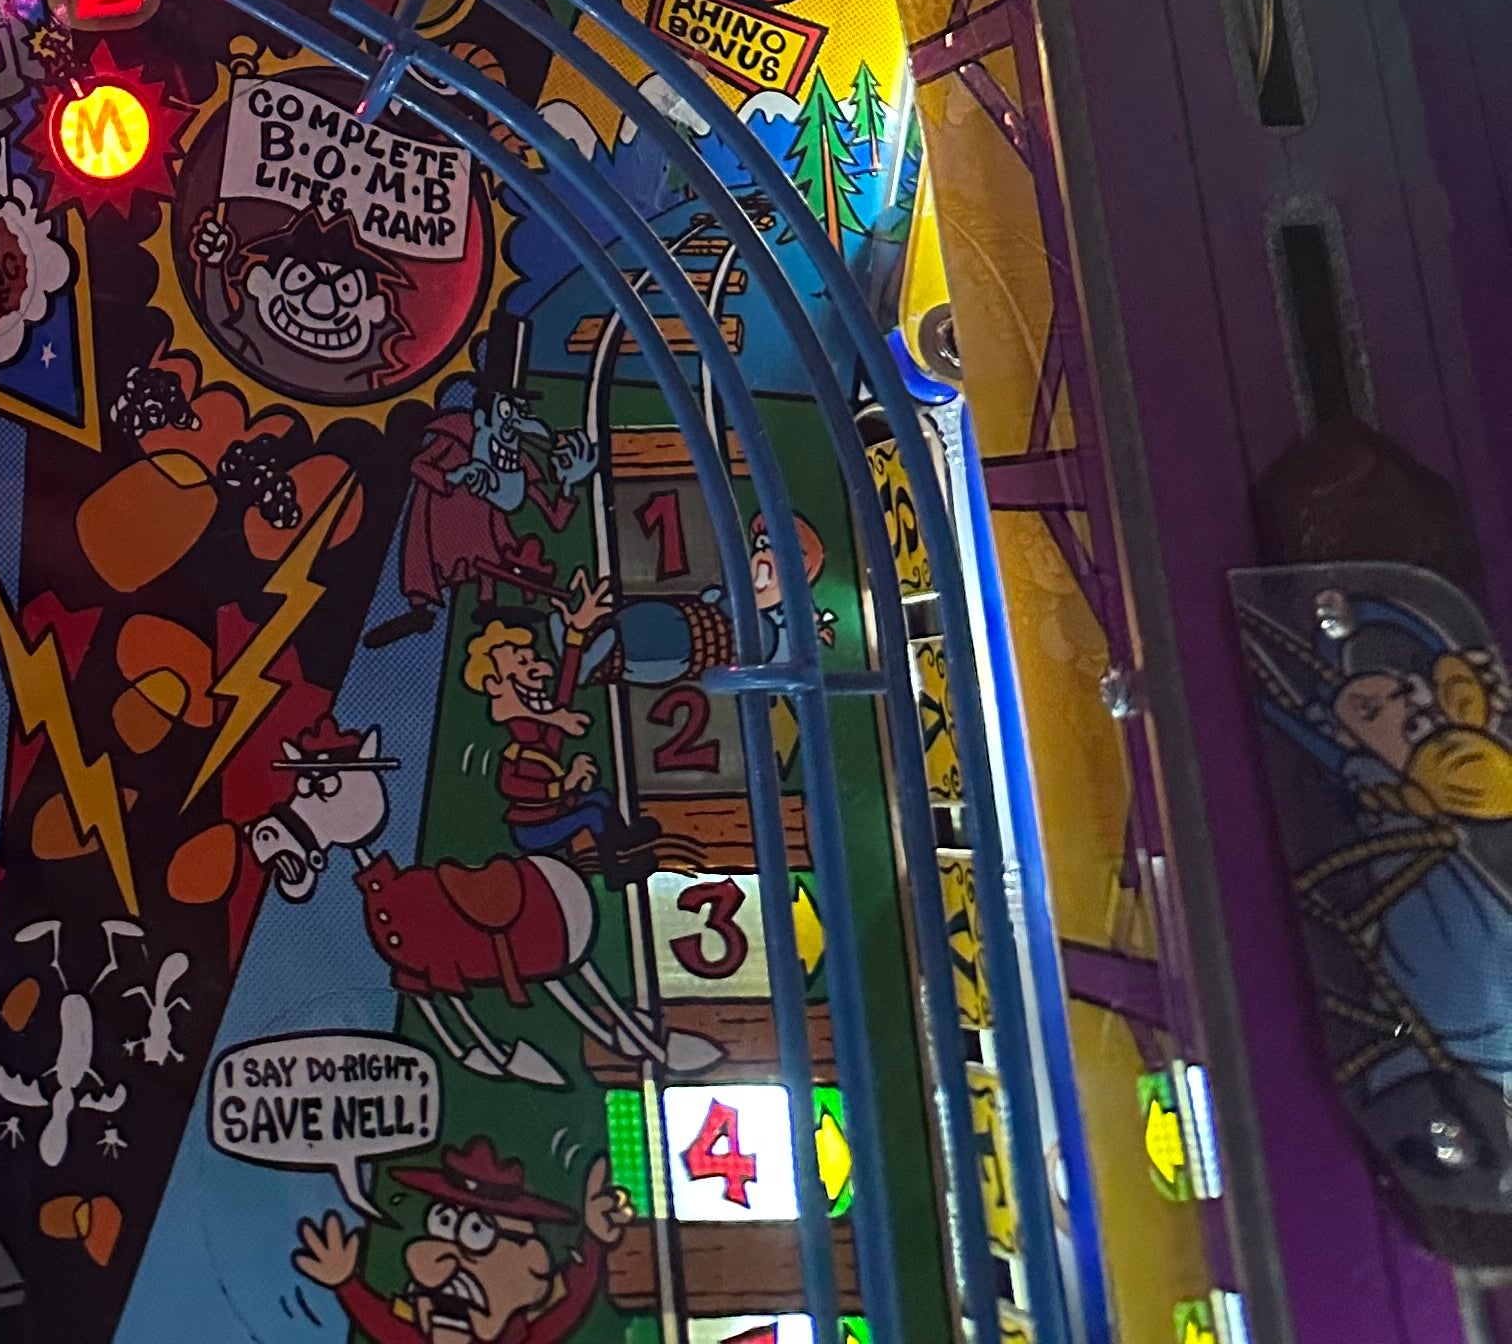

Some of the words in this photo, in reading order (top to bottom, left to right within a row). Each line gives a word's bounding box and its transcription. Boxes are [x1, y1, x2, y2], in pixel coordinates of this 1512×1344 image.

[668, 19, 780, 83] BONUS
[74, 96, 134, 160] M
[248, 88, 458, 180] COMPLETE
[255, 162, 348, 213] LITES
[363, 202, 456, 247] RAMP
[637, 492, 689, 578] 1
[651, 690, 720, 773] 2
[671, 878, 748, 977] 3
[224, 1060, 234, 1088] I
[243, 1055, 297, 1088] SAY
[306, 1052, 430, 1088] DO-RIGHT,
[219, 1095, 323, 1144] SAVE
[332, 1093, 430, 1141] NELL!
[681, 1097, 756, 1210] 4
